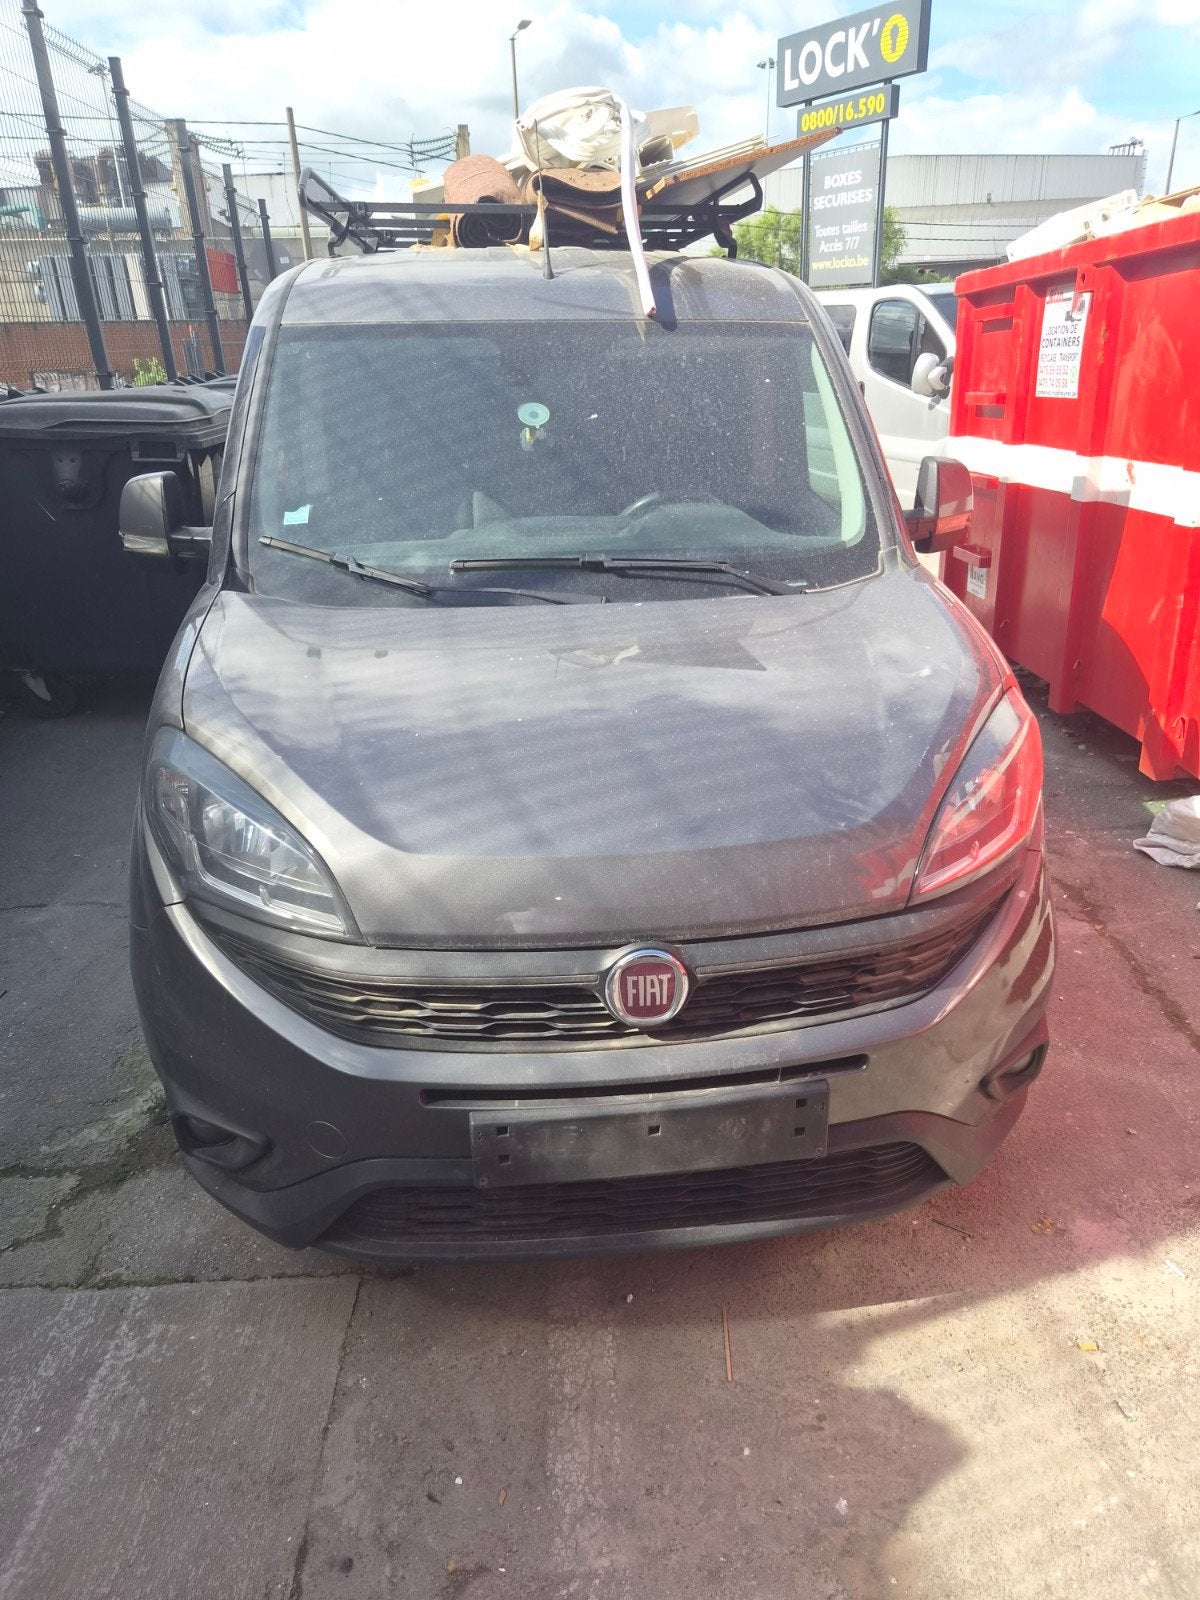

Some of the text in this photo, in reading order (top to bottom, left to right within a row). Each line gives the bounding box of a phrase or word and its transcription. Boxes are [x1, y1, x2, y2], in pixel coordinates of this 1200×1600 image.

[801, 93, 886, 132] 0800/16.590
[824, 169, 863, 190] BOXES
[813, 188, 873, 211] SECURISES
[815, 220, 868, 238] Toutes tailles
[819, 236, 860, 253] Accès 7/7
[811, 254, 870, 271] www.locko.be
[1045, 323, 1078, 336] LOCATION DE
[1042, 336, 1080, 348] CONTAINERS
[626, 973, 672, 1007] FIAT
